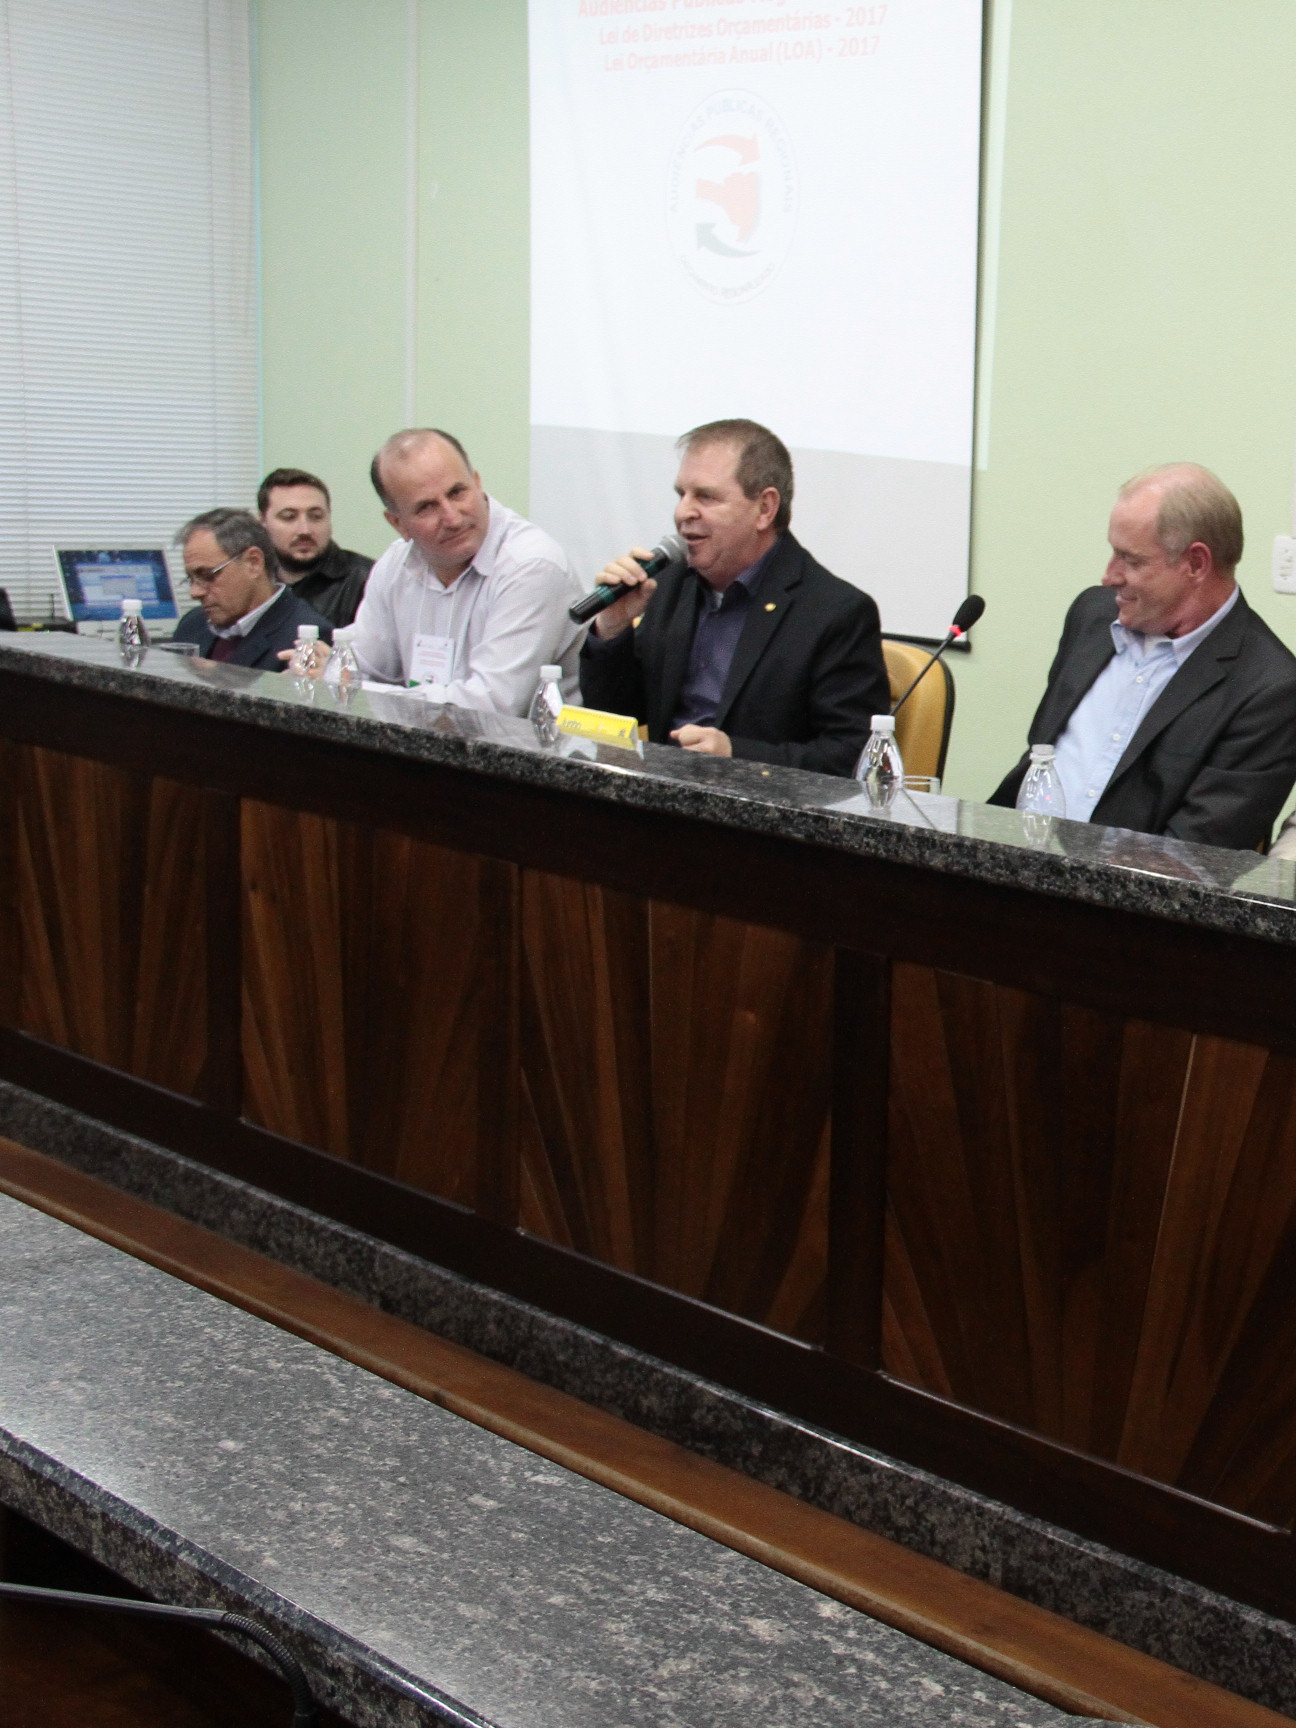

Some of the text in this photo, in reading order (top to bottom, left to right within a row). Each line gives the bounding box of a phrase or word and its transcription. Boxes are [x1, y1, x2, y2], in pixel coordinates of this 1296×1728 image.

[598, 26, 618, 45] Lei
[622, 23, 640, 43] de
[643, 20, 713, 41] Diretrizes
[716, 9, 832, 39] Orçamentárias
[844, 4, 888, 27] 2017
[604, 52, 625, 72] Lei
[627, 44, 727, 72] Orçamentária
[729, 40, 773, 64] Anual
[776, 37, 823, 68] (LOA)
[837, 35, 881, 58] 2017
